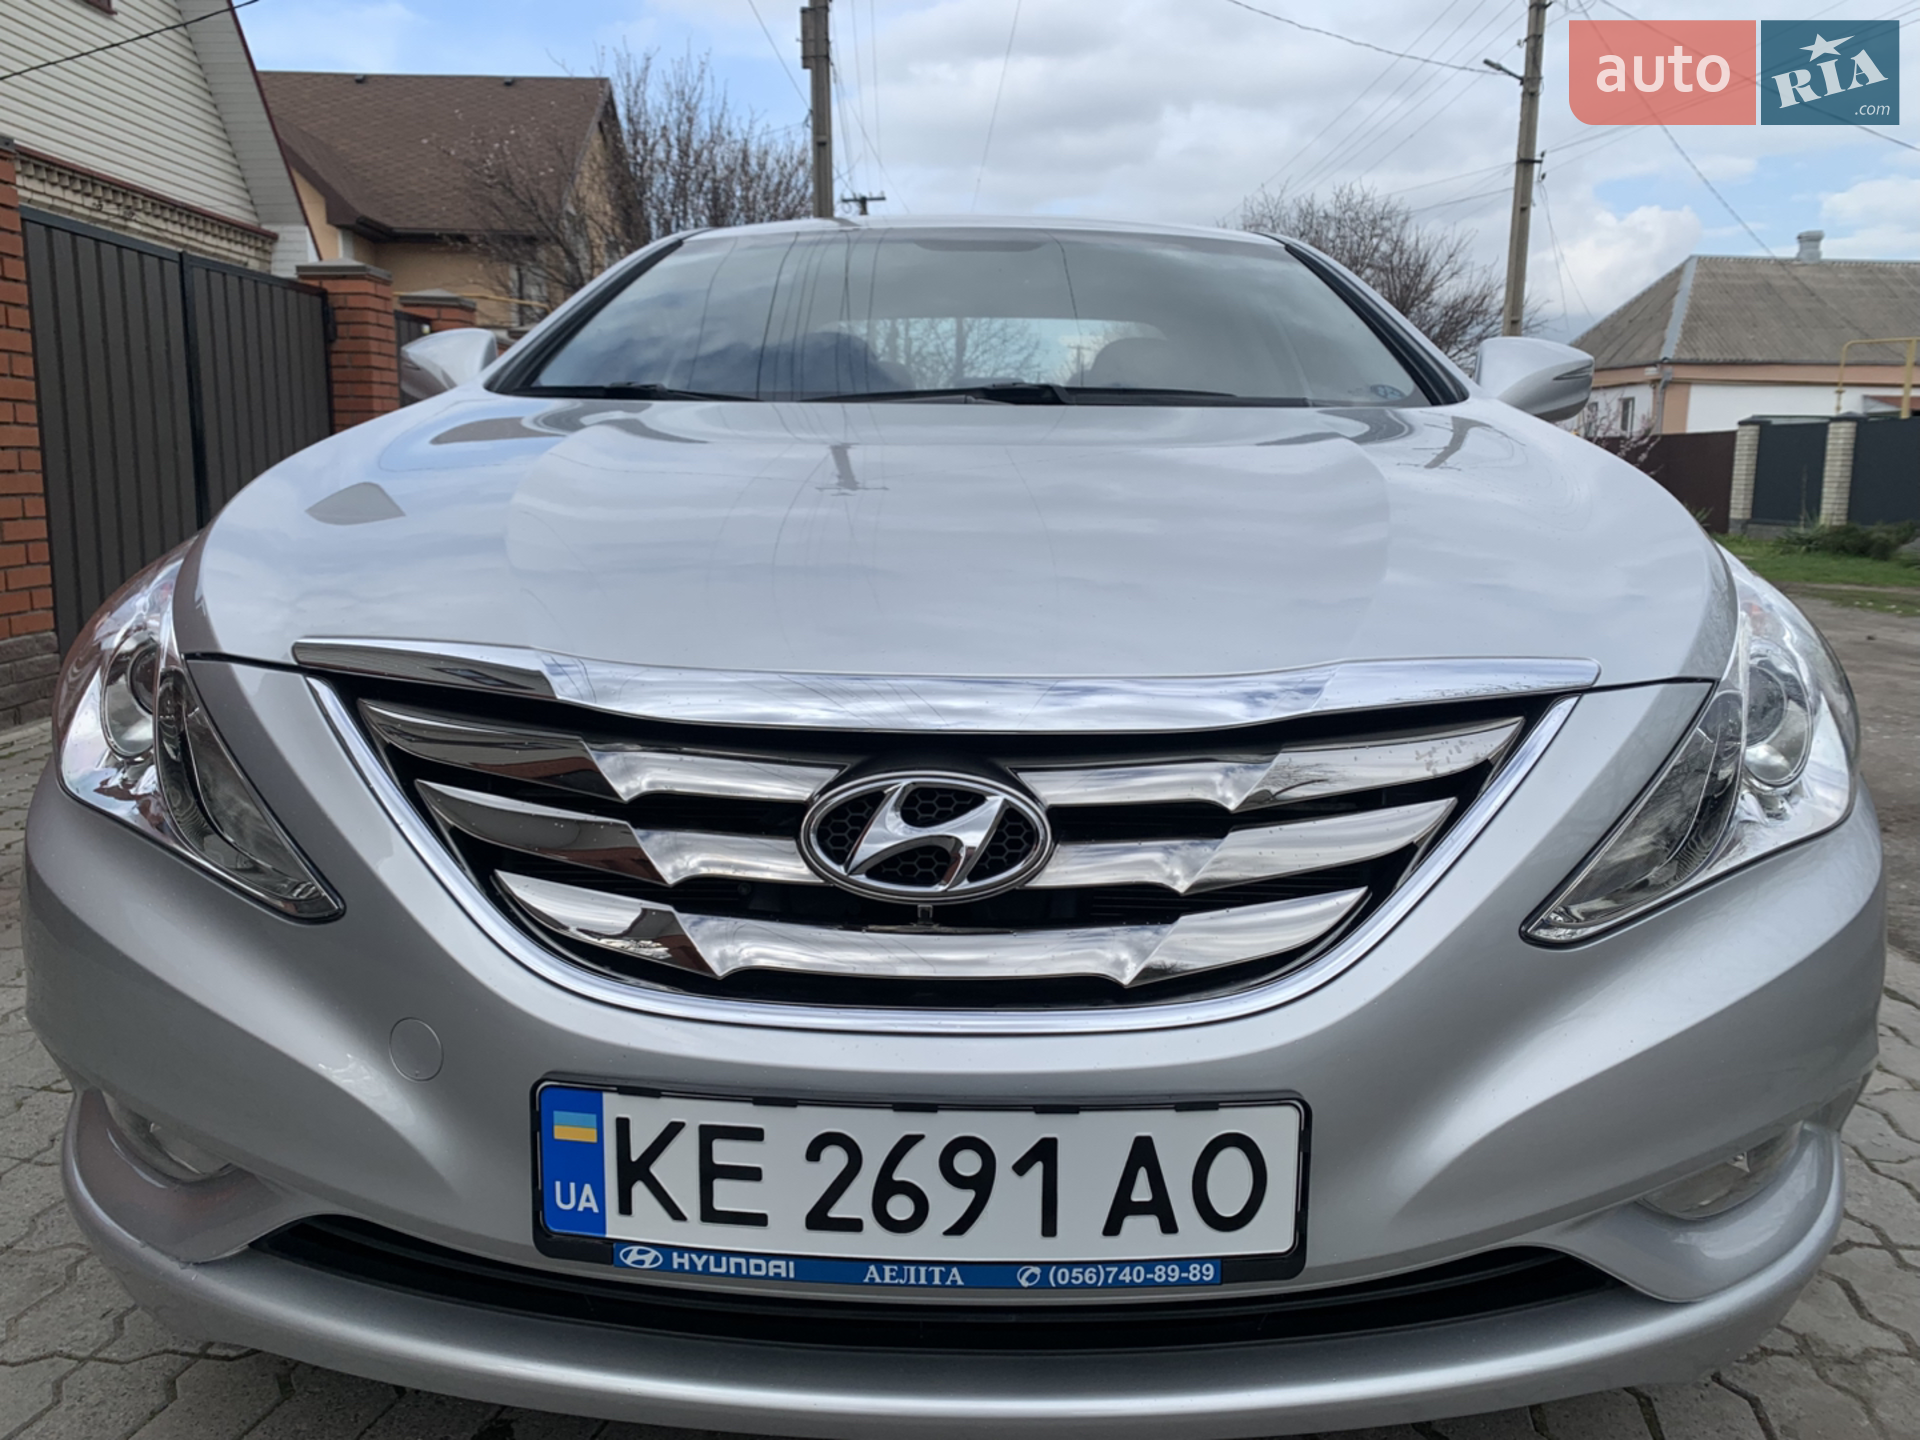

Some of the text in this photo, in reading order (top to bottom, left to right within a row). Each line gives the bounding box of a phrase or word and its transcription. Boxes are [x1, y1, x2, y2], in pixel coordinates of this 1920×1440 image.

[615, 1116, 1268, 1238] KE 2691 AO
[554, 1180, 599, 1213] UA
[672, 1251, 795, 1279] HYUNDAI
[1048, 1262, 1215, 1287] (056)740-89-89
